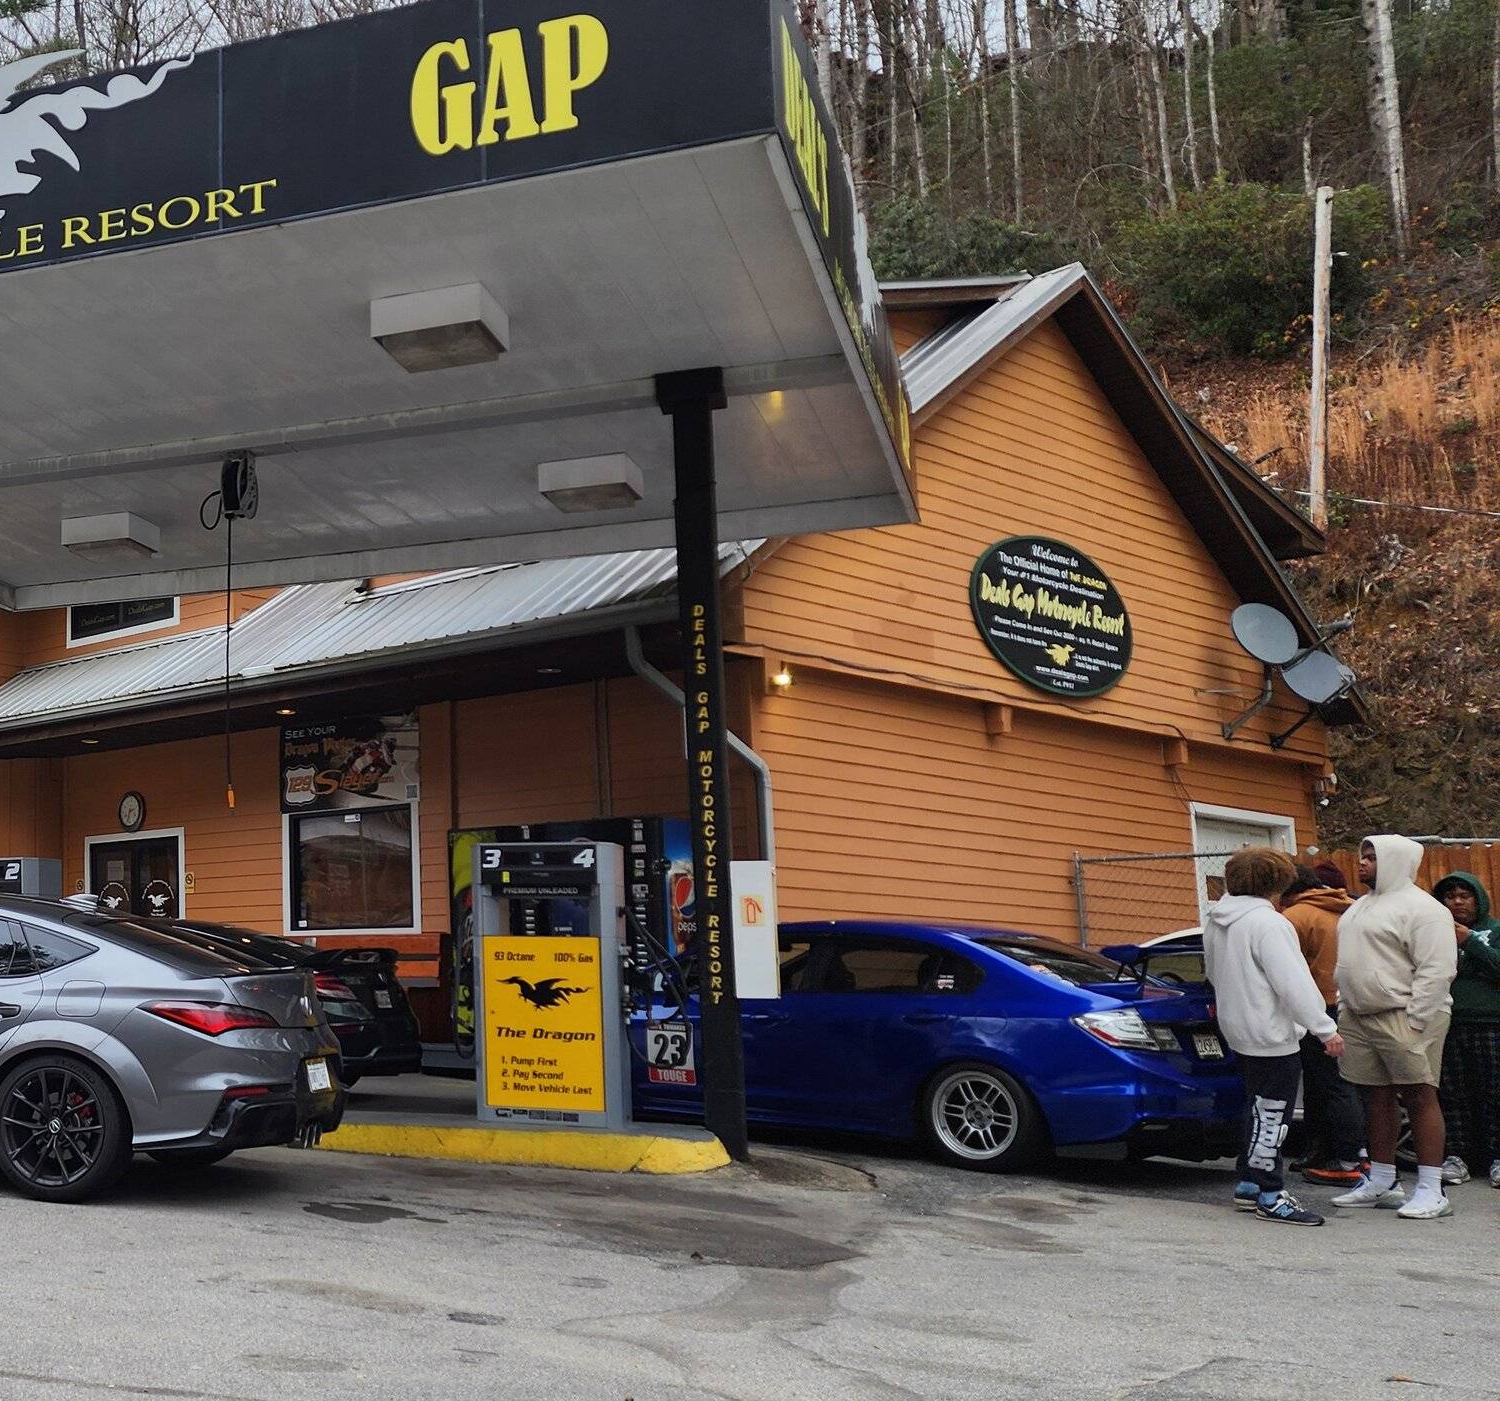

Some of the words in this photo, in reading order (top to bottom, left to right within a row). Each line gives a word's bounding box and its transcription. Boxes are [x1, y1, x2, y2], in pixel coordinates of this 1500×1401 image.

[410, 14, 609, 156] GAP
[60, 178, 277, 248] RESORT
[1032, 544, 1070, 565] Welcome
[999, 551, 1013, 565] The
[1013, 556, 1039, 572] Official
[1040, 562, 1060, 578] Home
[1061, 569, 1068, 580] of
[1002, 566, 1018, 577] Your
[1031, 573, 1069, 590] Motorcycle
[1069, 584, 1105, 600] Destination
[980, 572, 1011, 608] Deals
[1012, 583, 1035, 620] Gap
[1037, 587, 1092, 630] Motorcycle
[1092, 604, 1125, 637] Resort
[693, 605, 706, 675] DEALS
[697, 692, 710, 733] GAP
[285, 730, 305, 740] SEE
[307, 725, 336, 737] YOUR
[699, 750, 718, 898] MOTORCYCLE
[482, 849, 501, 868] 3
[573, 849, 595, 868] 4
[5, 863, 20, 880] 2
[677, 922, 697, 933] peps
[494, 951, 504, 961] 93
[507, 952, 535, 961] Octane
[554, 952, 575, 962] 100%
[578, 953, 593, 963] Gas
[708, 915, 723, 1005] RESORT
[496, 1027, 526, 1039] The
[533, 1028, 596, 1043] Dragon
[654, 1034, 687, 1066] 23
[501, 1056, 507, 1065] 1.
[511, 1057, 535, 1067] Pump
[537, 1058, 557, 1067] First
[501, 1069, 510, 1077] 2.
[512, 1070, 530, 1080] Pay
[532, 1070, 564, 1080] Second
[658, 1069, 688, 1082] TOUGE
[502, 1082, 510, 1091] 3.
[513, 1083, 536, 1092] Move
[539, 1084, 570, 1094] Vehicle
[573, 1085, 592, 1095] Last
